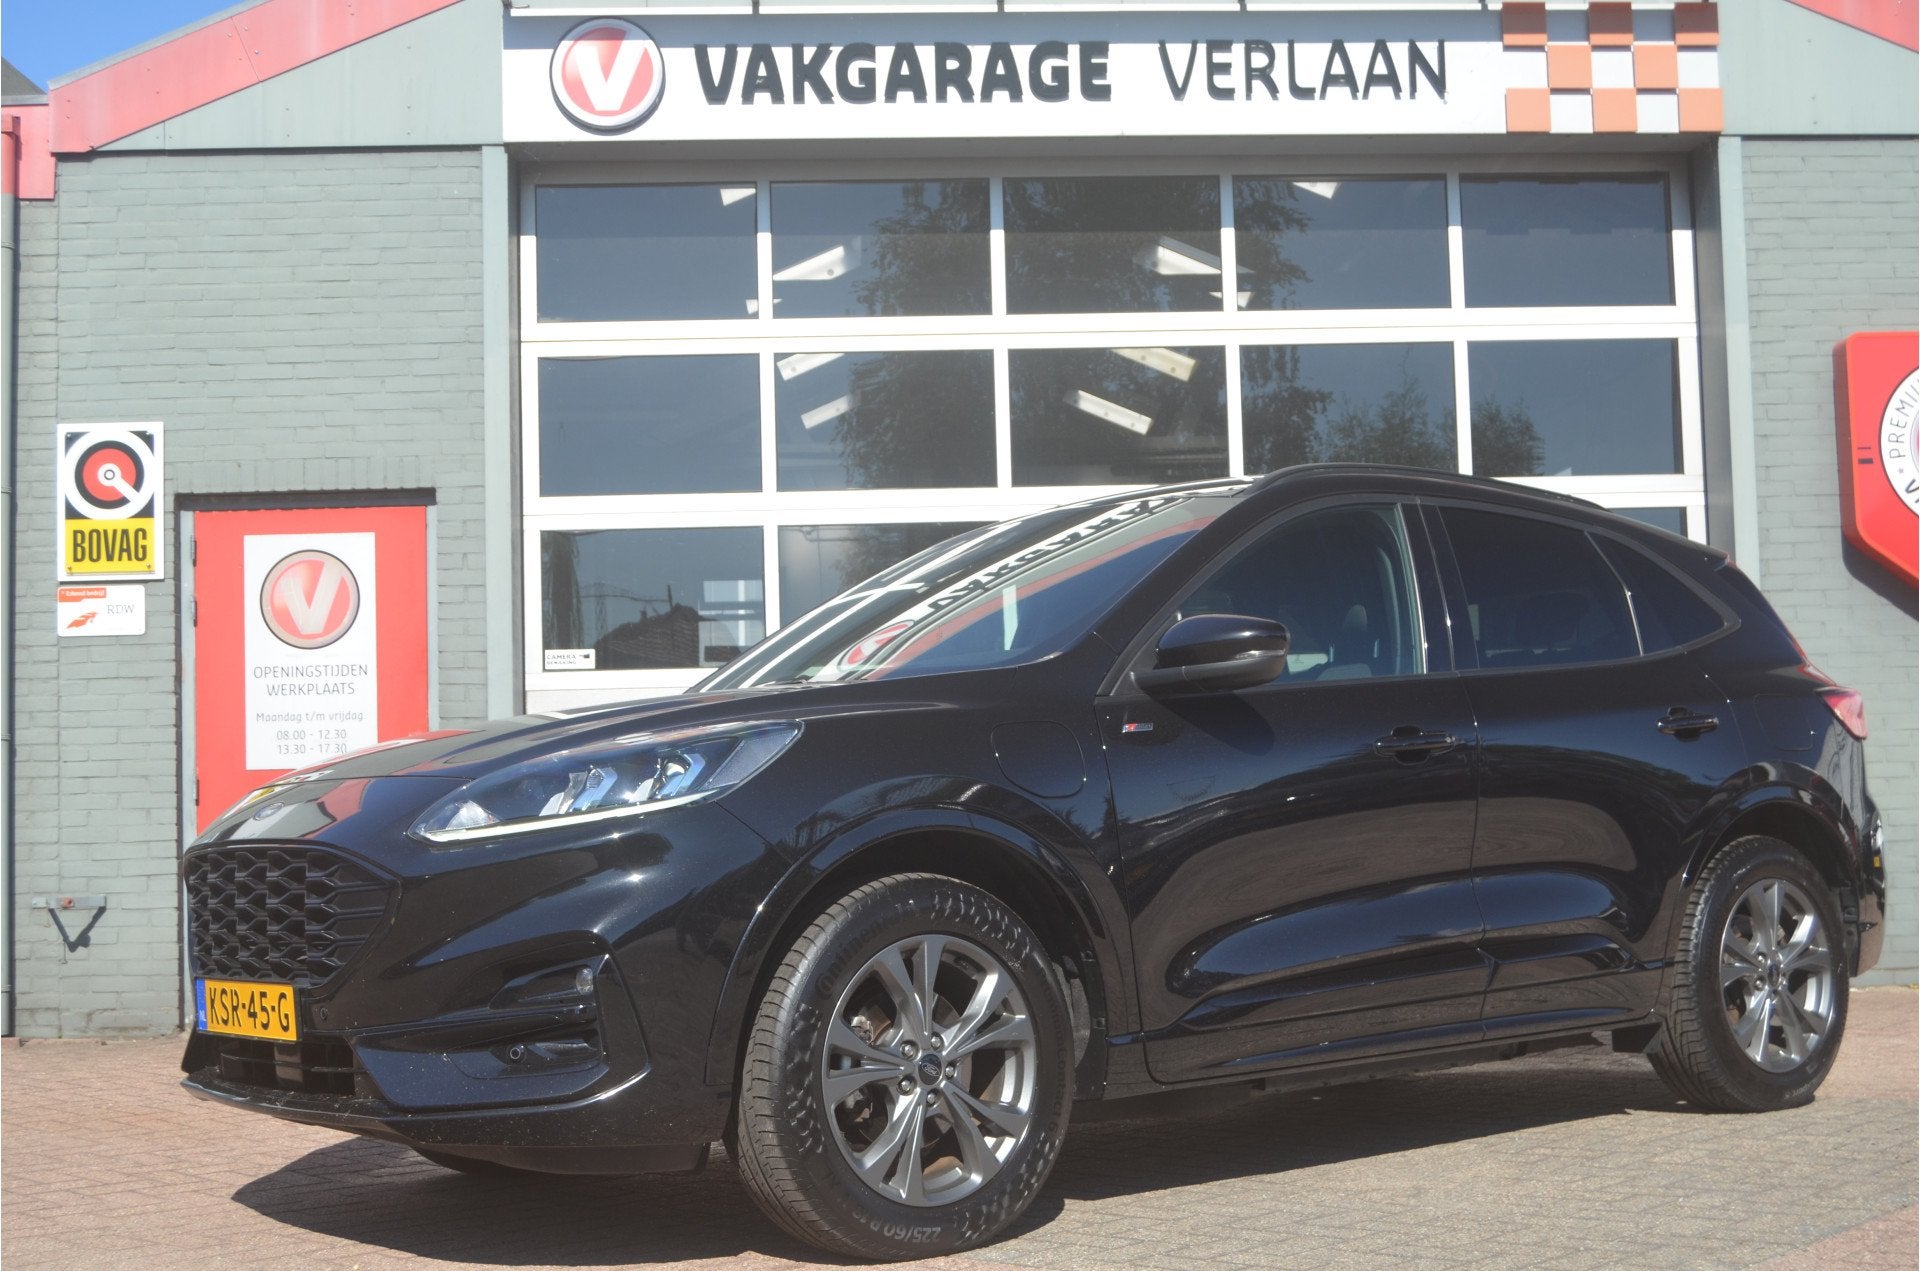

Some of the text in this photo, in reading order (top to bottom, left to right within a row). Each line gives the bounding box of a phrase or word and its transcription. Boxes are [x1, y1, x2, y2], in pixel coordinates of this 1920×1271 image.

[693, 38, 1447, 106] VAKGARAGE VERLAAN
[72, 527, 148, 563] BOVAG
[107, 604, 134, 615] RDW
[253, 664, 368, 679] OPENINGSTIJDEN
[266, 682, 355, 696] WERKPLAATS
[256, 712, 302, 723] Maandag
[305, 711, 325, 721] t/m
[276, 730, 306, 741] 08.00
[319, 729, 347, 740] 12.30
[278, 744, 306, 755] 13.30
[209, 986, 290, 1033] KSR-45-G
[883, 1223, 942, 1244] 225/60
